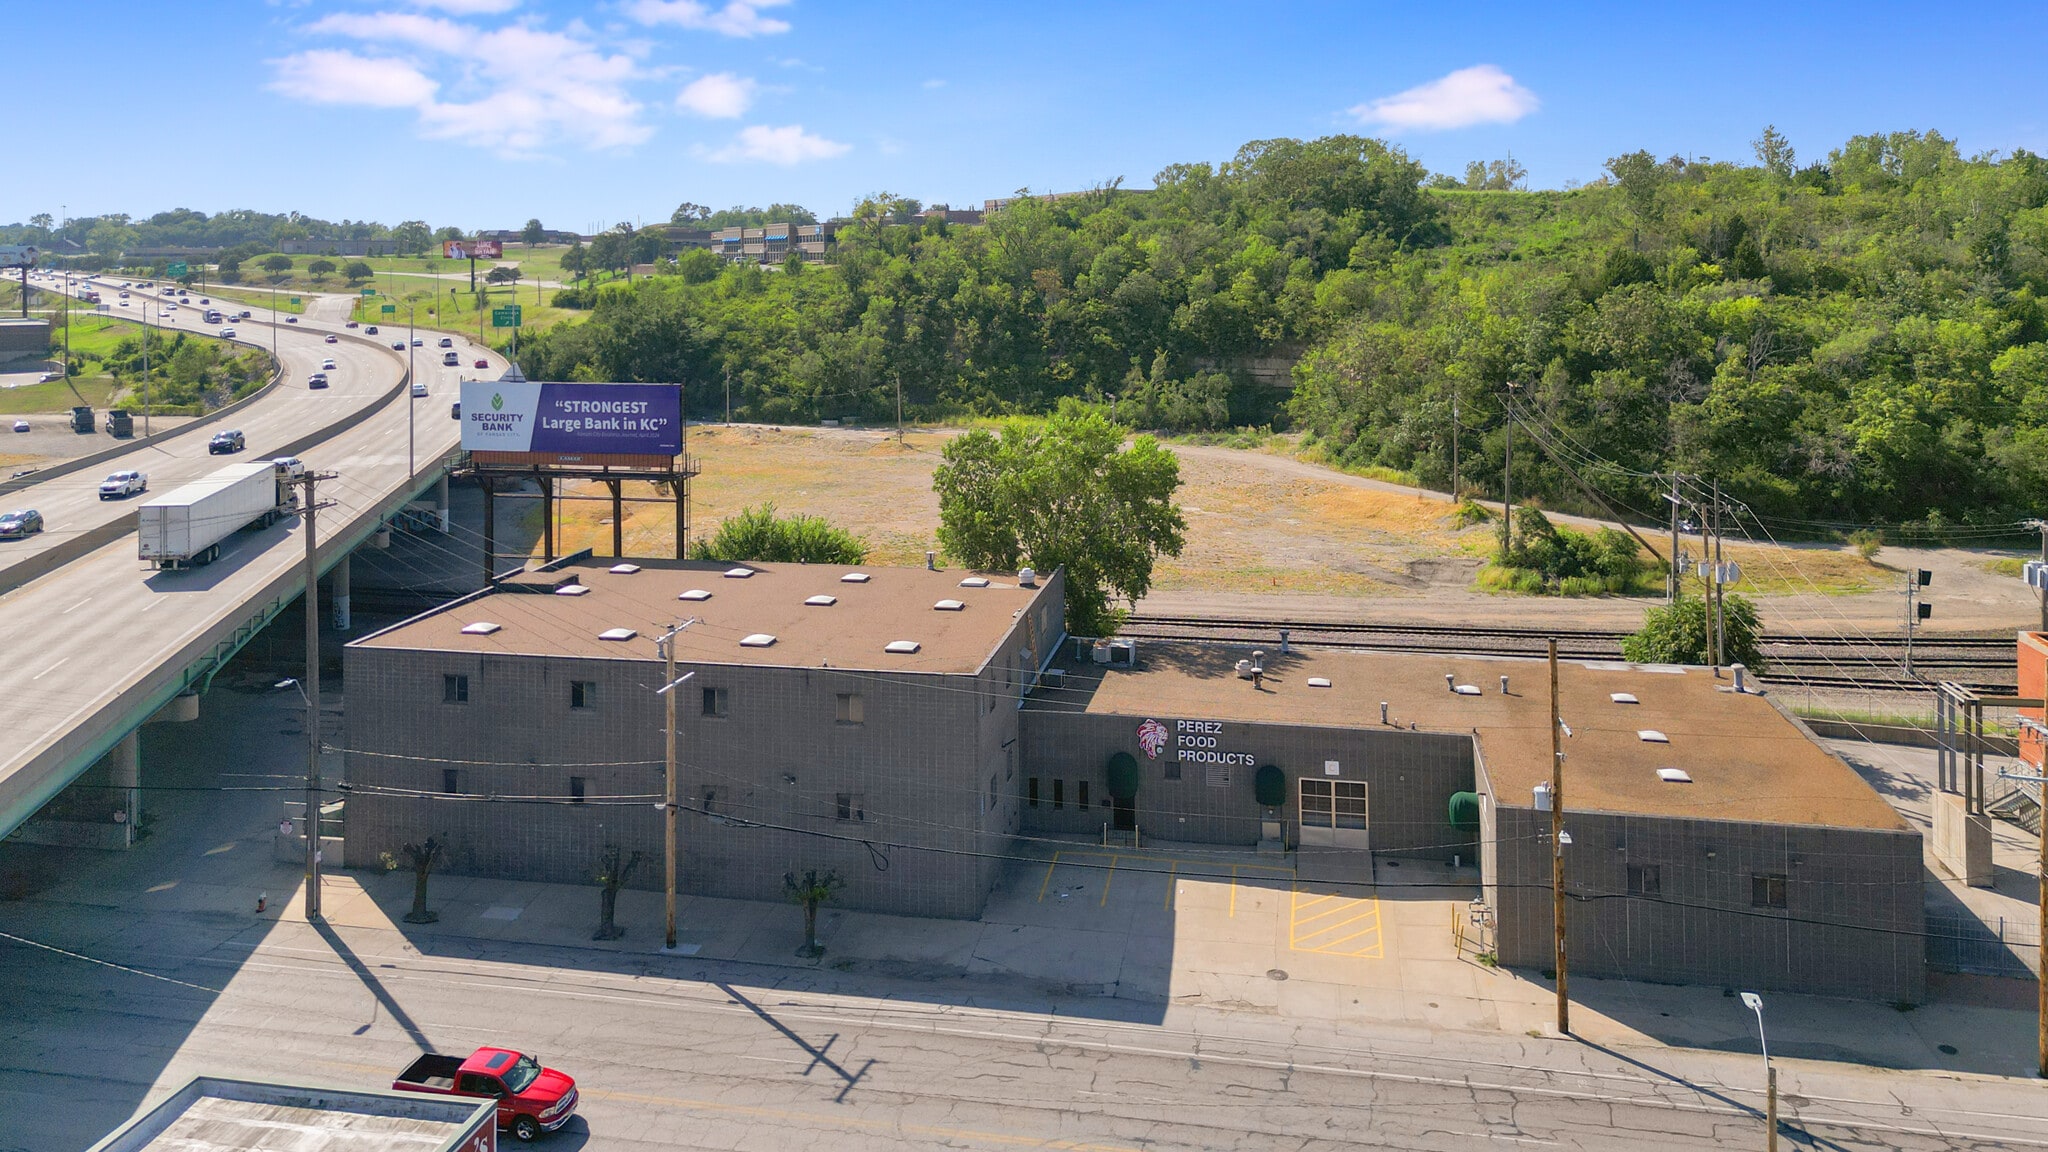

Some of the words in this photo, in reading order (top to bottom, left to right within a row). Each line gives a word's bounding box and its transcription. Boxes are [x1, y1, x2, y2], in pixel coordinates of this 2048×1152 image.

[554, 400, 648, 414] “STRONGEST
[471, 413, 523, 422] SECURITY
[542, 417, 581, 432] Large
[584, 417, 620, 431] Bank
[623, 417, 636, 430] in
[640, 418, 667, 431] KC”
[482, 423, 513, 431] BANK
[1177, 720, 1223, 734] PEREZ
[1177, 735, 1217, 748] FOOD
[1178, 750, 1255, 766] PRODUCTS
